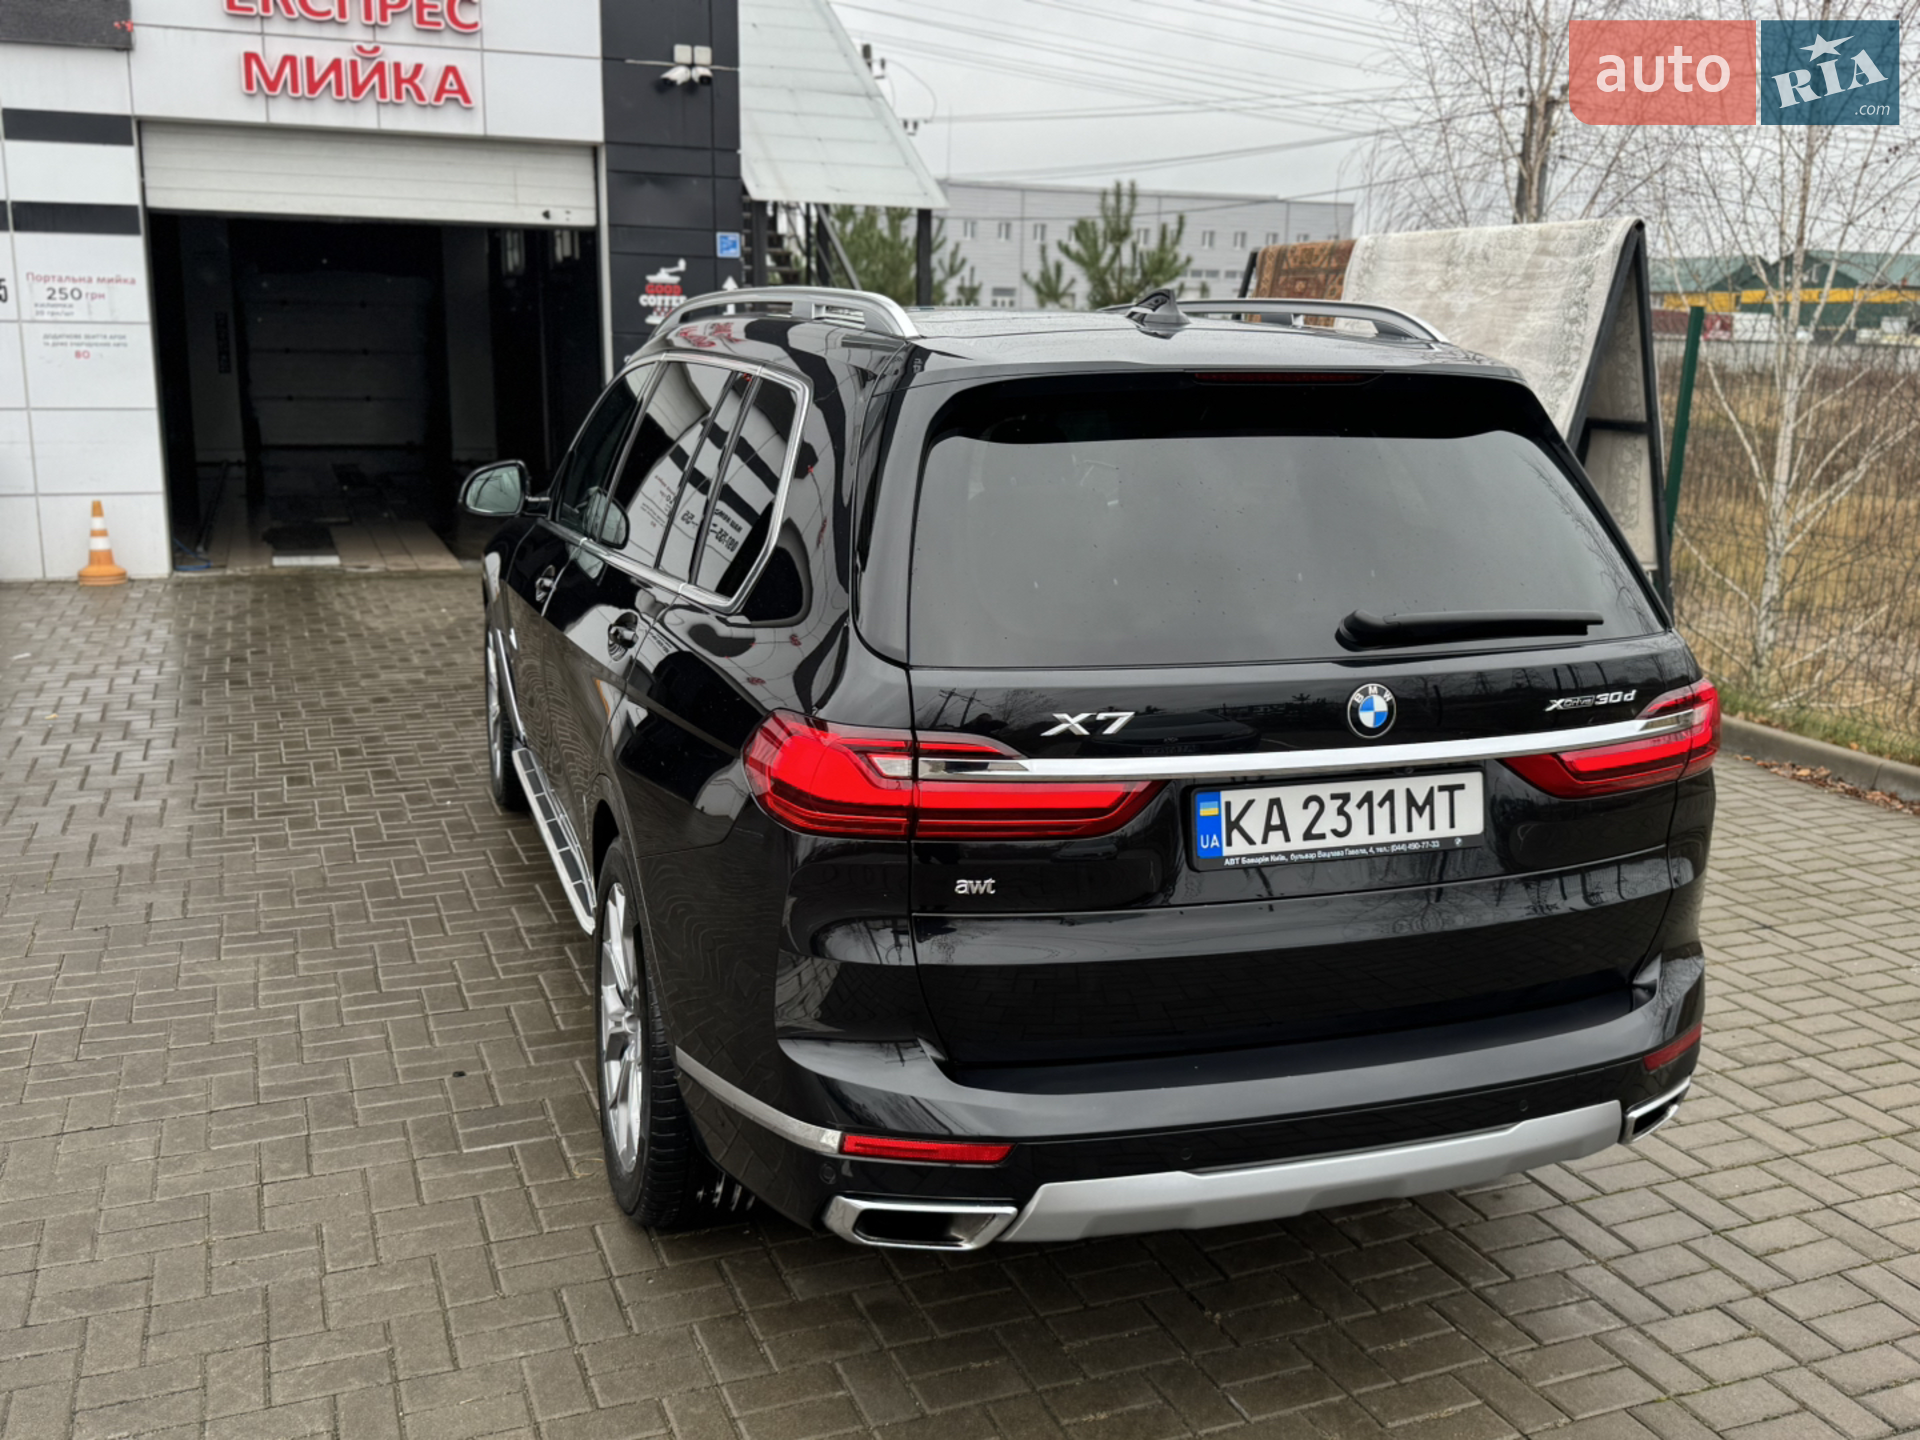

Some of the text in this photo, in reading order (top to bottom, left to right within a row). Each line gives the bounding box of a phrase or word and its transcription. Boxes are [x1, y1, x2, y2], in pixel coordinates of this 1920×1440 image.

[242, 44, 474, 107] МИЙКА
[26, 271, 136, 285] Портальна мийка
[46, 287, 105, 302] 250 грн
[645, 284, 682, 296] GOOD
[1354, 685, 1393, 704] BMW
[1040, 711, 1135, 736] X7
[1200, 834, 1220, 849] UA
[955, 878, 996, 895] awt
